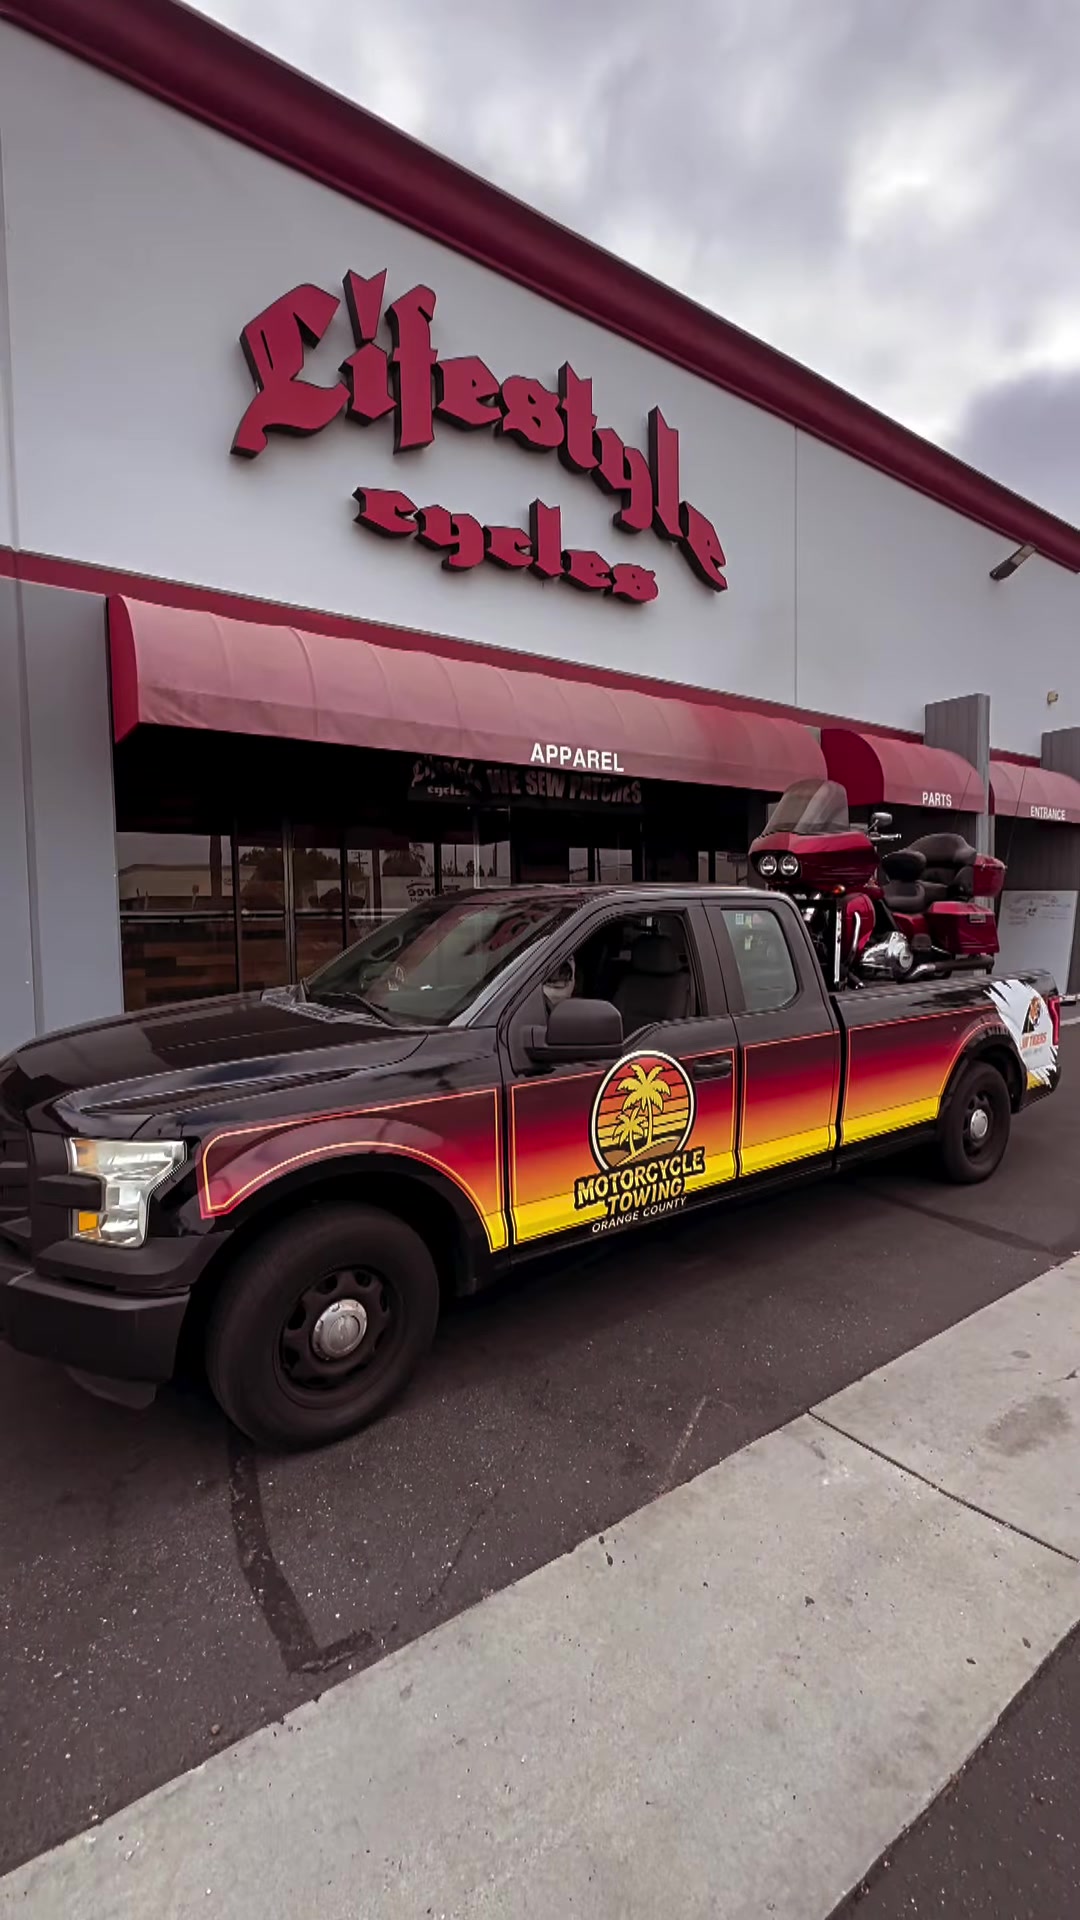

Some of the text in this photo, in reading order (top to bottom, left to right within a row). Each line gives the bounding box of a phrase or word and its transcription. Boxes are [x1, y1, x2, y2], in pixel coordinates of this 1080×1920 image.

[230, 268, 728, 592] Lifestyle
[352, 486, 658, 604] cycles
[530, 742, 625, 773] APPAREL
[486, 769, 522, 794] WE
[524, 770, 566, 798] SEW
[922, 791, 952, 807] PARTS
[1030, 805, 1066, 821] ENTRANCE
[576, 1149, 704, 1207] MOTORCYCLE
[607, 1177, 685, 1216] TOWING
[592, 1195, 687, 1233] ORANGE COUNTY
